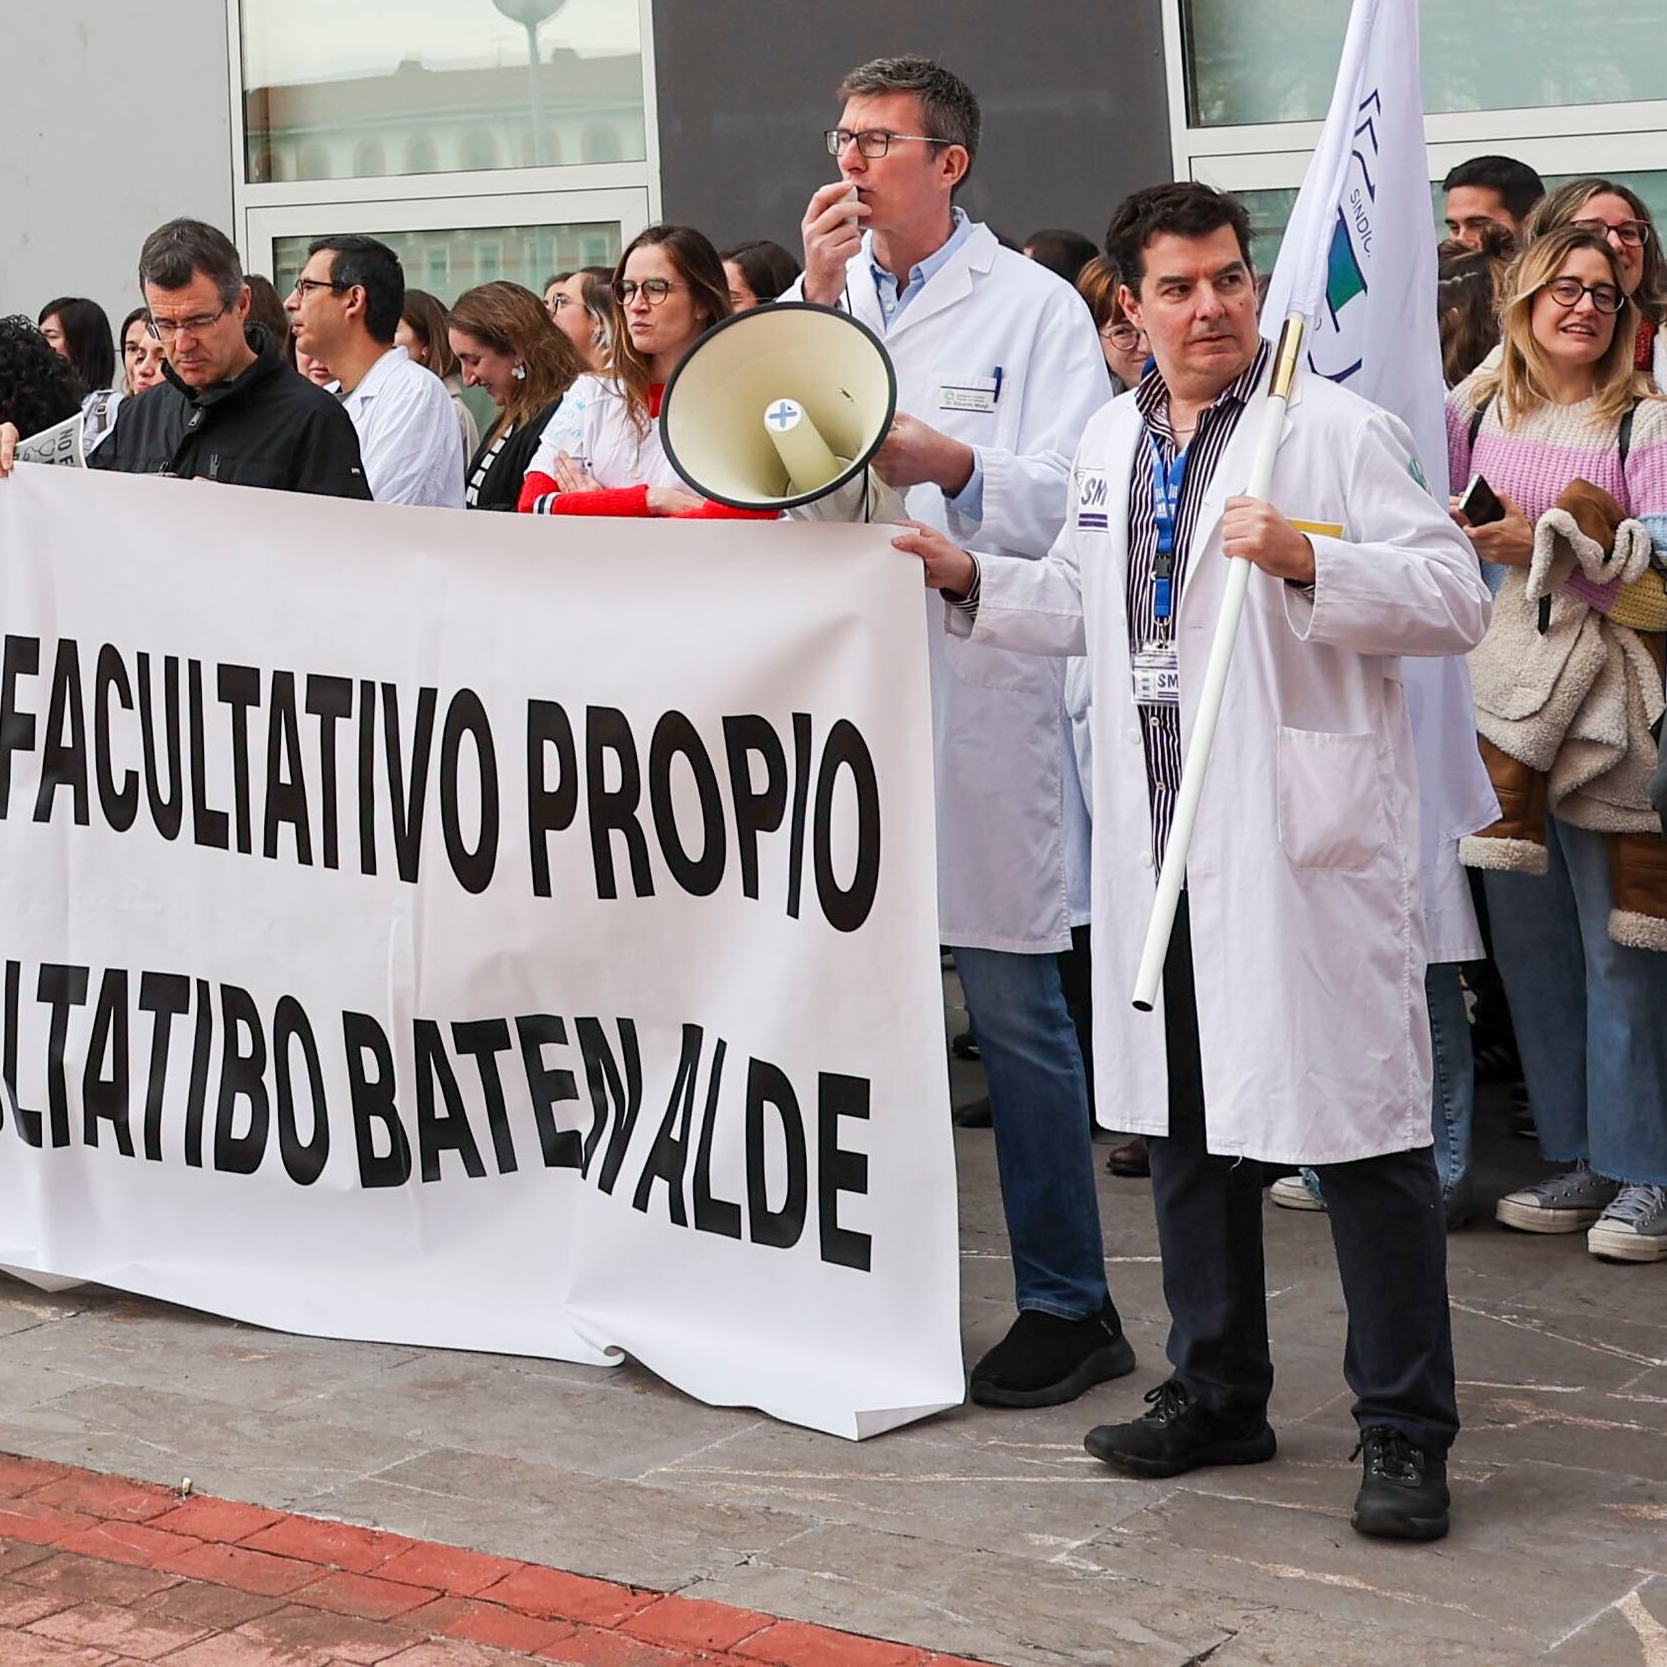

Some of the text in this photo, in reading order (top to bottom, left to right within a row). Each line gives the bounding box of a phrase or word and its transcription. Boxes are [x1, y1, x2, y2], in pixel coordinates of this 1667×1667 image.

[525, 697, 881, 933] PROPIO
[341, 1010, 650, 1195] BATEN
[633, 1021, 873, 1273] ALDE
